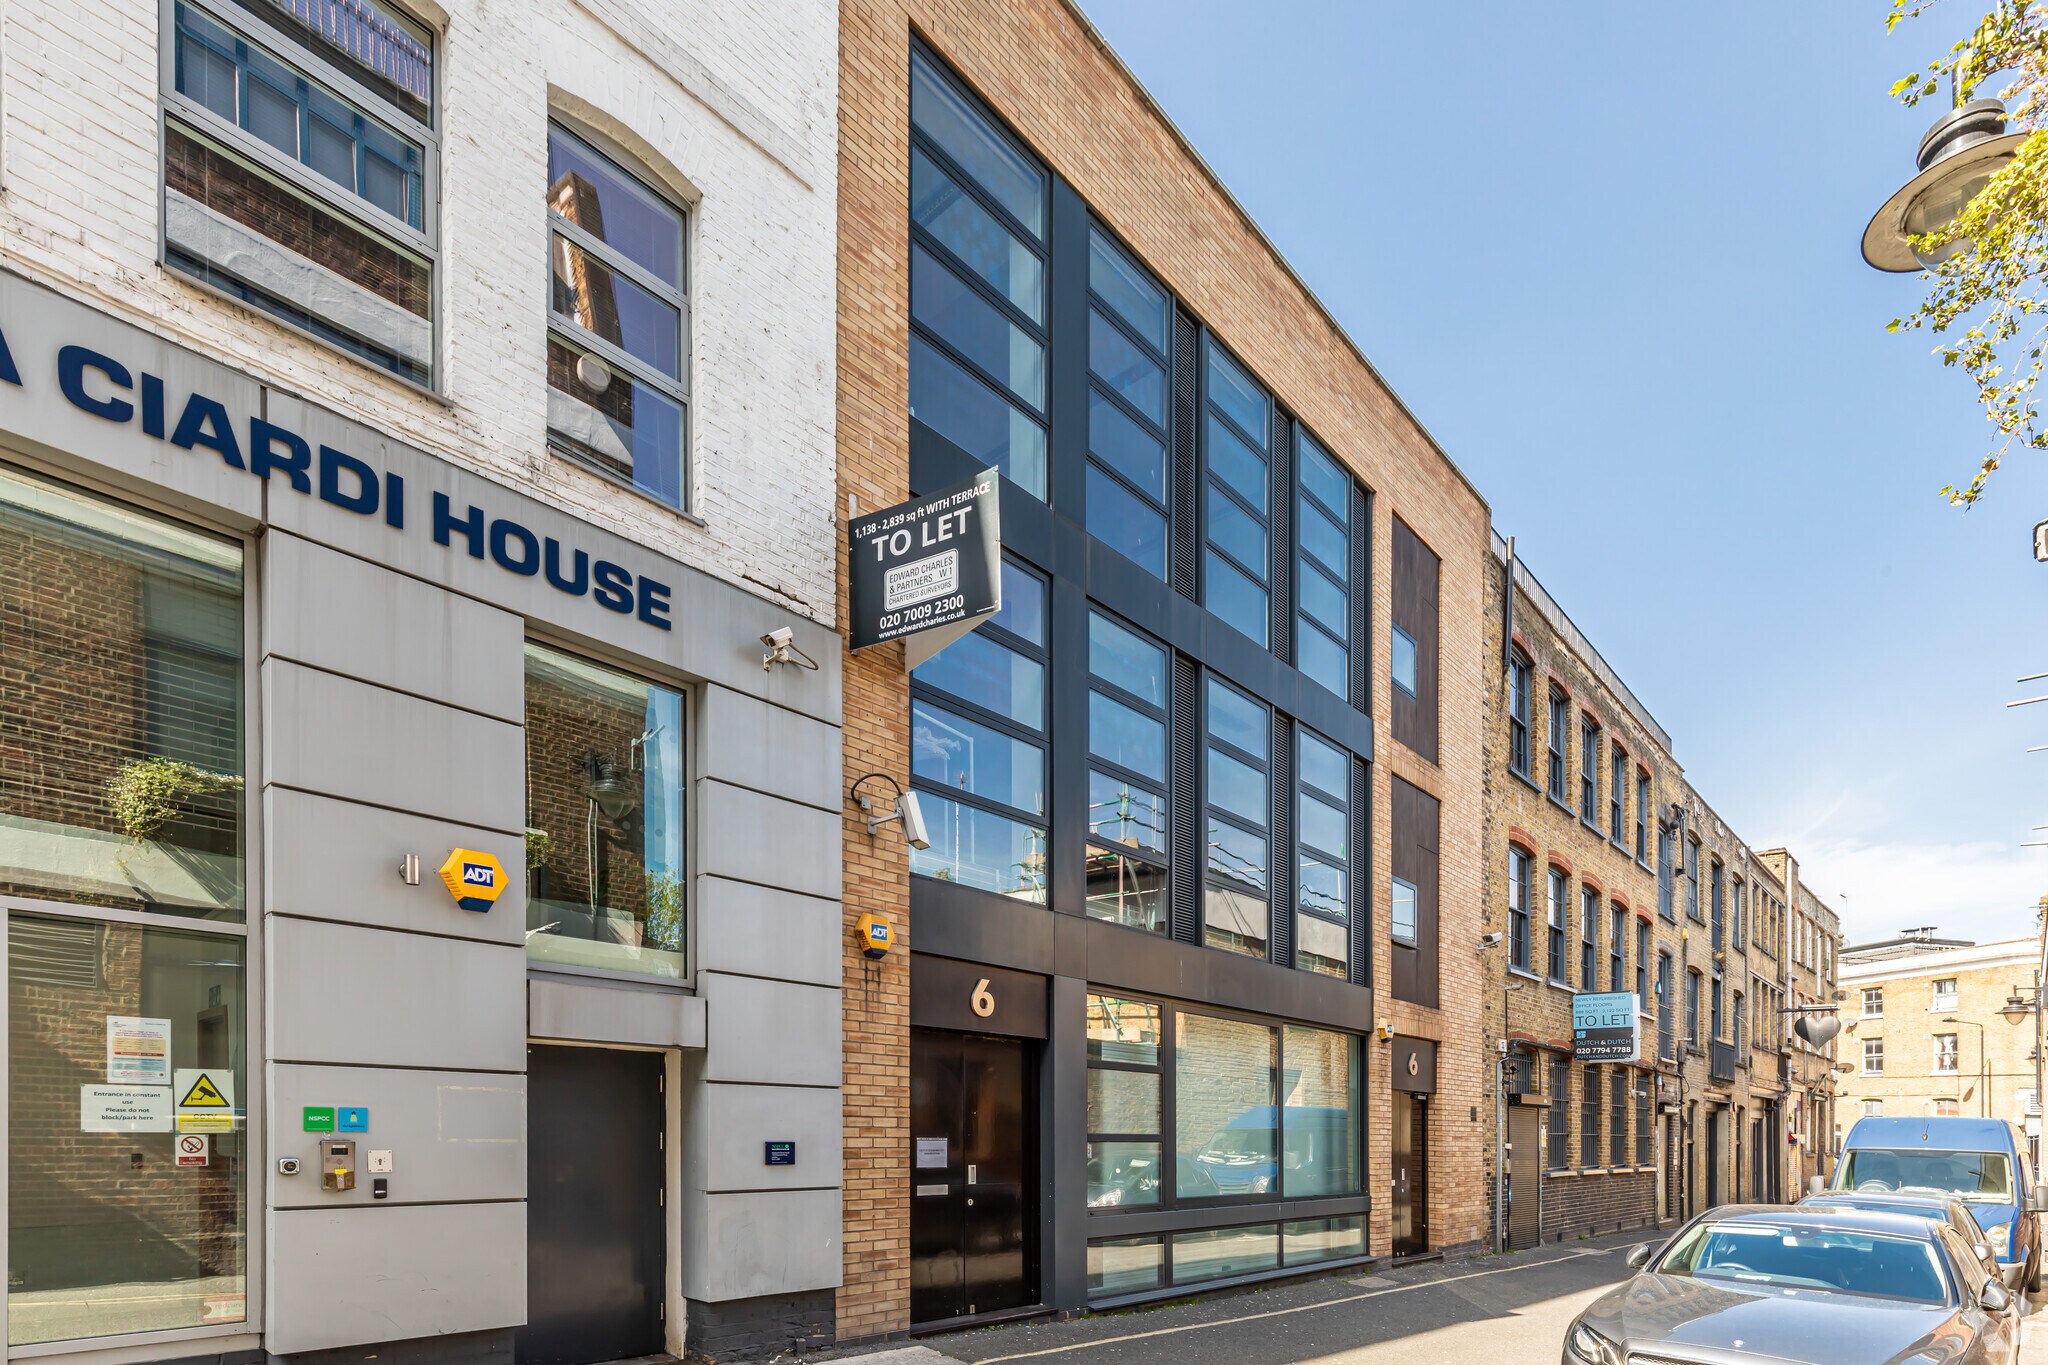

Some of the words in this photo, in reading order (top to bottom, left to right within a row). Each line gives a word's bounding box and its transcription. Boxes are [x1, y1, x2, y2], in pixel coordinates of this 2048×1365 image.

[57, 345, 404, 529] CIARDI
[433, 490, 671, 631] HOUSE
[855, 522, 877, 539] 1,138
[882, 513, 904, 530] 2,839
[906, 512, 916, 523] sq
[917, 507, 925, 517] ft
[926, 498, 950, 514] WITH
[951, 481, 990, 506] TERRACE
[872, 529, 912, 562] TO
[922, 506, 972, 548] LET
[889, 567, 920, 584] EDWARD
[921, 556, 953, 574] CHARLES
[889, 585, 895, 594] &
[896, 573, 933, 592] PARTNERS
[888, 592, 919, 605] CHARTERED
[920, 580, 952, 596] SURVEYORS
[878, 609, 965, 639] www.edwardcharles.co.uk
[879, 613, 901, 629] 020
[903, 604, 931, 623] 7009
[934, 594, 964, 614] 2300
[464, 867, 494, 884] ADT
[871, 927, 888, 938] ADT
[970, 978, 995, 1018] 6
[1575, 1015, 1597, 1027] TO
[1602, 1014, 1629, 1026] LET
[1408, 1052, 1419, 1076] 6
